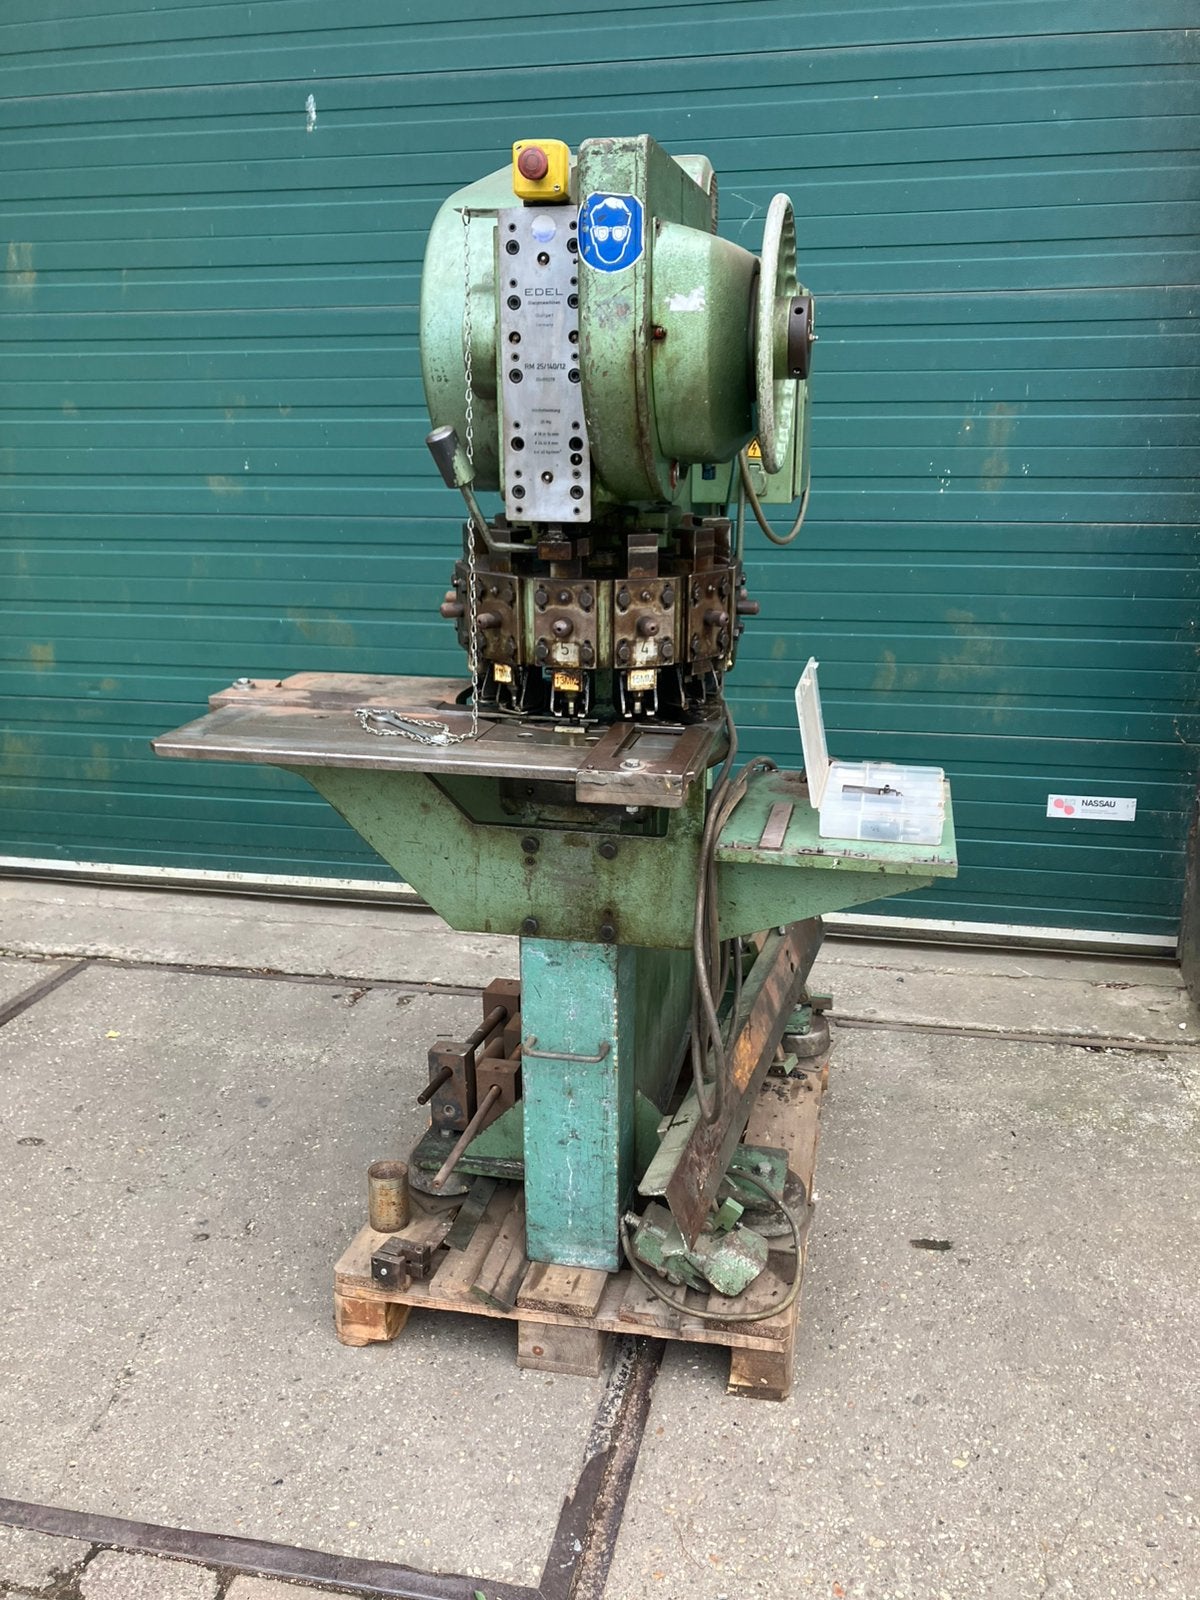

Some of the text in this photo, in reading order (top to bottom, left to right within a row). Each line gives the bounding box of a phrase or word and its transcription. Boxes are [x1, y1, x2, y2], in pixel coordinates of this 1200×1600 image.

[524, 288, 563, 296] EDEL
[561, 642, 569, 655] 5
[641, 641, 649, 654] 4
[1081, 800, 1116, 808] NASSAU
